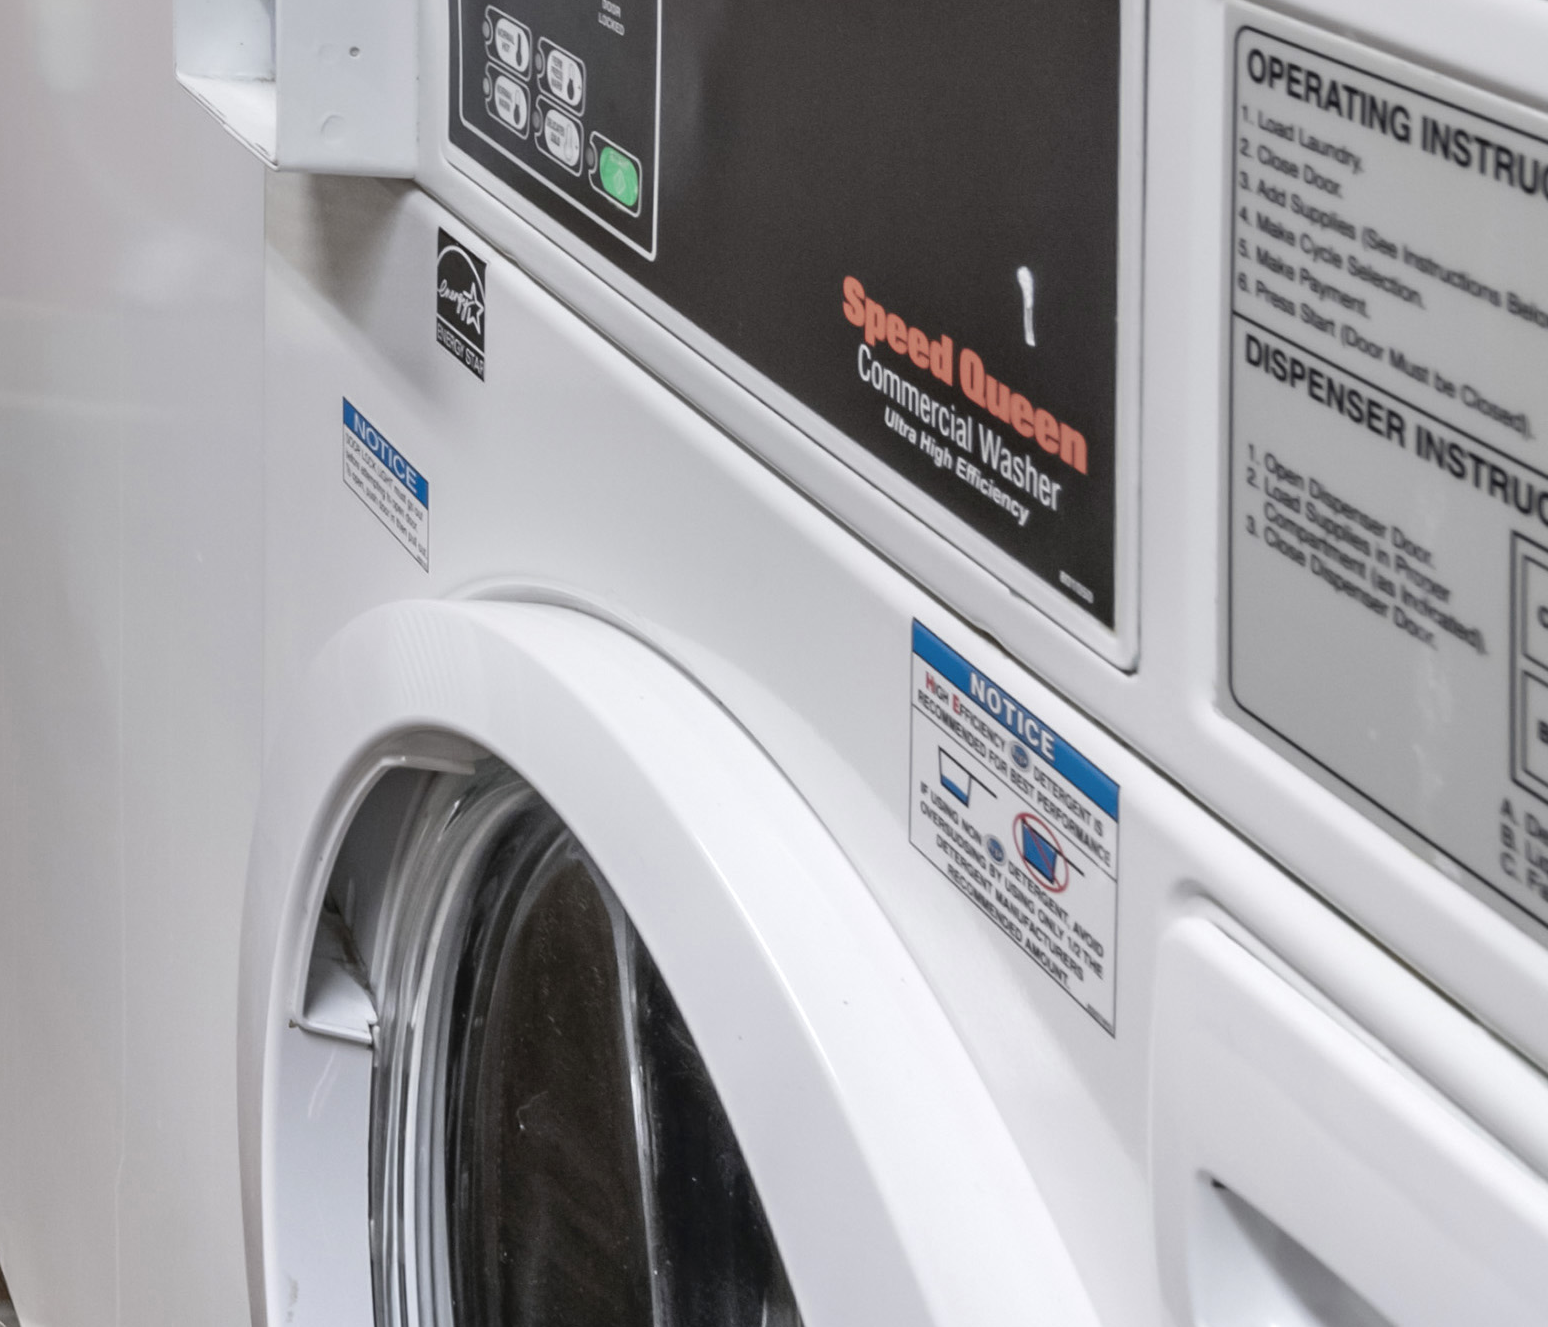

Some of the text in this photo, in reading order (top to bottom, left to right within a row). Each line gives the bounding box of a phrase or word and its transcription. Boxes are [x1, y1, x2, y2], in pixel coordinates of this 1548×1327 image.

[598, 12, 625, 36] LOCKED
[1239, 137, 1343, 199] 2. Close Door.
[1241, 104, 1365, 175] 1. Load Laundry.
[1247, 48, 1548, 203] OPERATING INSTRU
[1238, 238, 1371, 319] 5. Make Payment.
[1239, 171, 1253, 192] 3.
[1257, 178, 1286, 208] Add
[1290, 193, 1356, 241] Supplies
[1361, 226, 1398, 260] (See
[1403, 245, 1502, 308] Instructions
[1239, 206, 1426, 310] 4. Make Cycle Selection.
[437, 322, 465, 358] ENERGY
[842, 275, 1088, 475] Speed Queen
[1238, 272, 1536, 440] 6. Press Start (Door Must be Closed).
[1245, 333, 1406, 448] DISPENSER
[354, 412, 417, 494] NOTICE
[858, 343, 1062, 511] Commercial Washer
[884, 406, 1031, 527] Ultra High Efficiency
[1246, 467, 1451, 603] 2. Load Supplies in Proper
[1264, 452, 1304, 491] Open
[1309, 477, 1387, 539] Dispenser
[1391, 526, 1436, 570] Door.
[1264, 501, 1366, 580] Compartment
[1370, 567, 1396, 598] (as
[1246, 514, 1438, 651] 3. Close Dispenser Door.
[918, 689, 986, 759] RECOMMENDED
[988, 751, 1008, 776] FOR
[1010, 768, 1035, 802] BEST
[1036, 789, 1111, 868] PERFORMANCE
[925, 671, 1103, 838] HIGH EFFICIENCY DETERGENT IS
[970, 672, 1056, 762] NOTICE
[920, 780, 1105, 959] IF USING NON DETERGENT, AVOID
[920, 800, 987, 870] OVERSUDSING
[989, 867, 1002, 884] BY
[1004, 875, 1036, 915] USING
[1037, 908, 1065, 940] ONLY
[1066, 935, 1082, 957] 1/2
[1082, 952, 1104, 980] THE
[936, 833, 993, 892] DETERGENT
[995, 887, 1084, 982] MANUFACTURERS
[947, 862, 1071, 990] RECOMMENDED AMOUNT.
